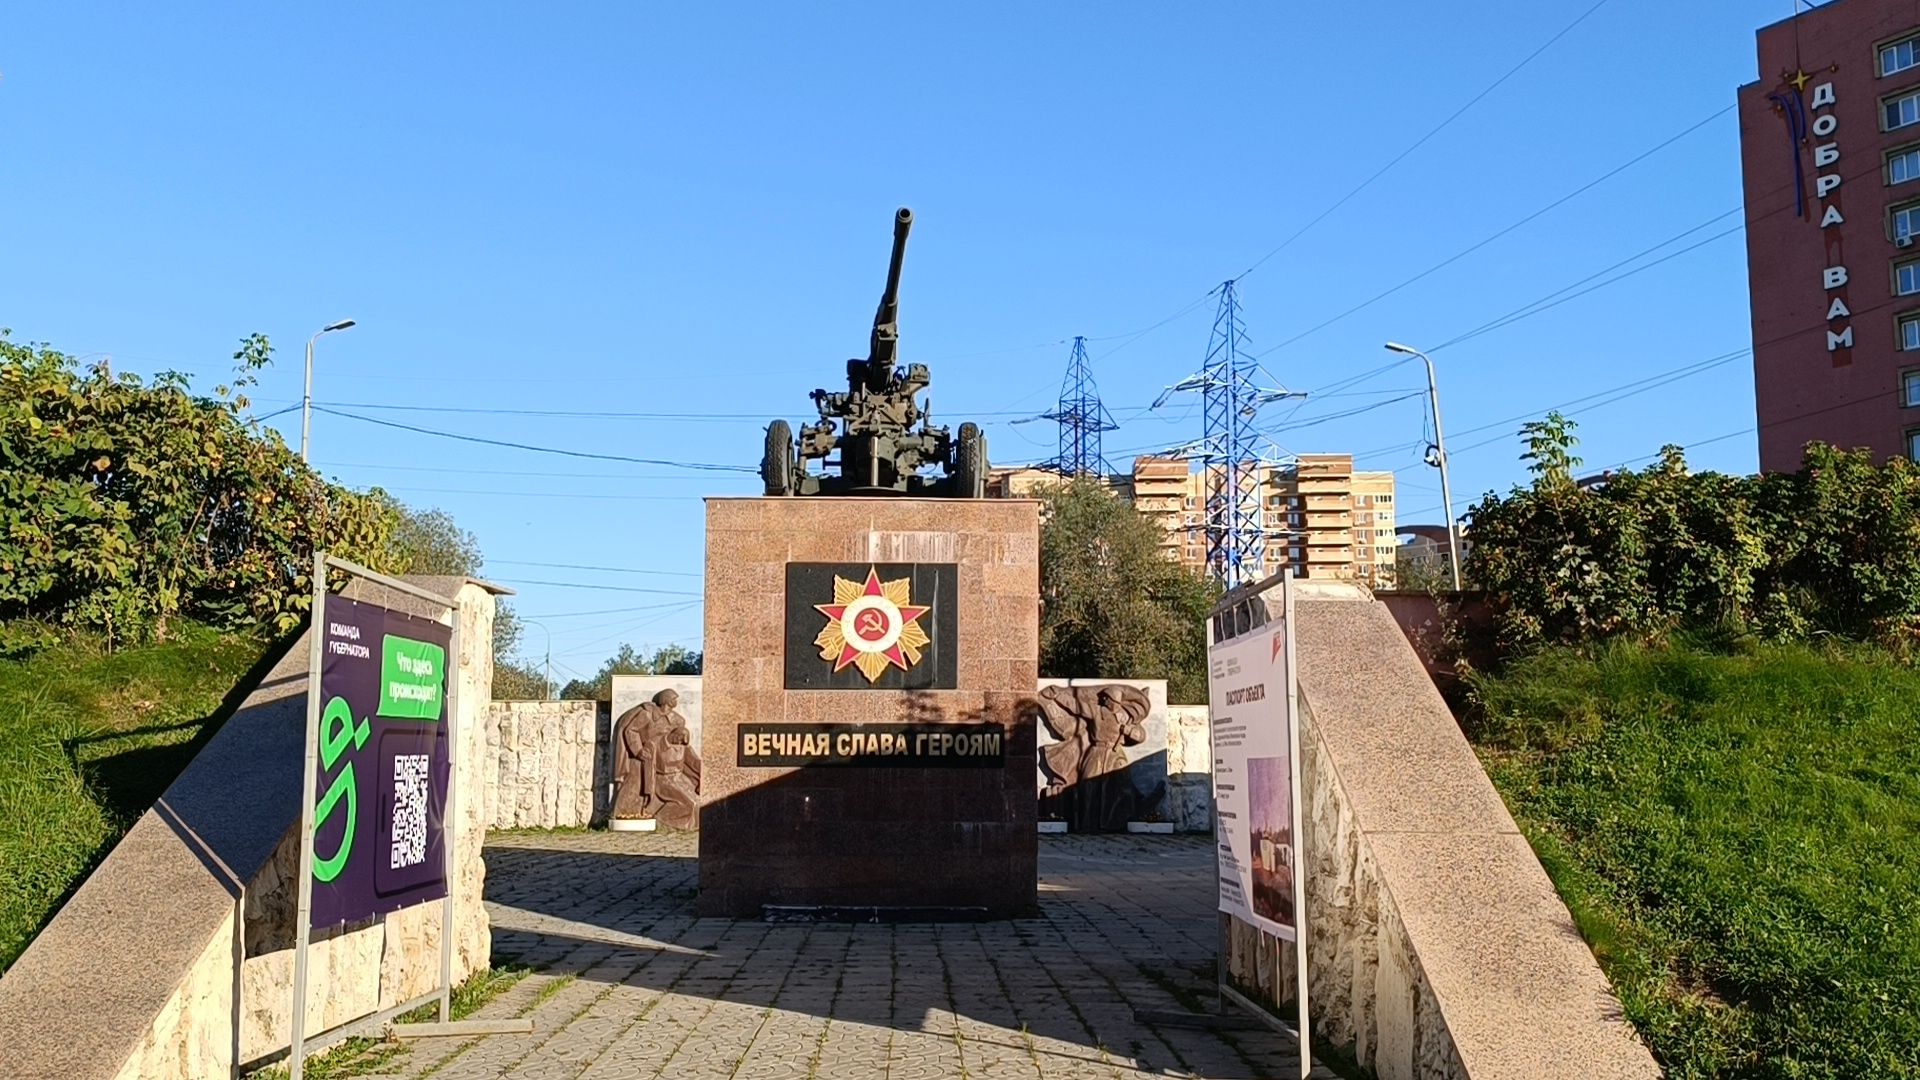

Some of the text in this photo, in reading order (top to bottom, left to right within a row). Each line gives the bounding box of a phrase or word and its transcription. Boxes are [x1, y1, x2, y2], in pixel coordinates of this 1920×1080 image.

[1811, 82, 1853, 352] ДОБРА ВАМ
[330, 622, 360, 640] КОМАНДА
[329, 641, 370, 659] ГУБЕРНАТОРА
[396, 651, 433, 677] Что здесь
[389, 681, 437, 703] происходит?
[743, 733, 1000, 756] ВЕЧНАЯ СЛАВА ГЕРОЯМ
